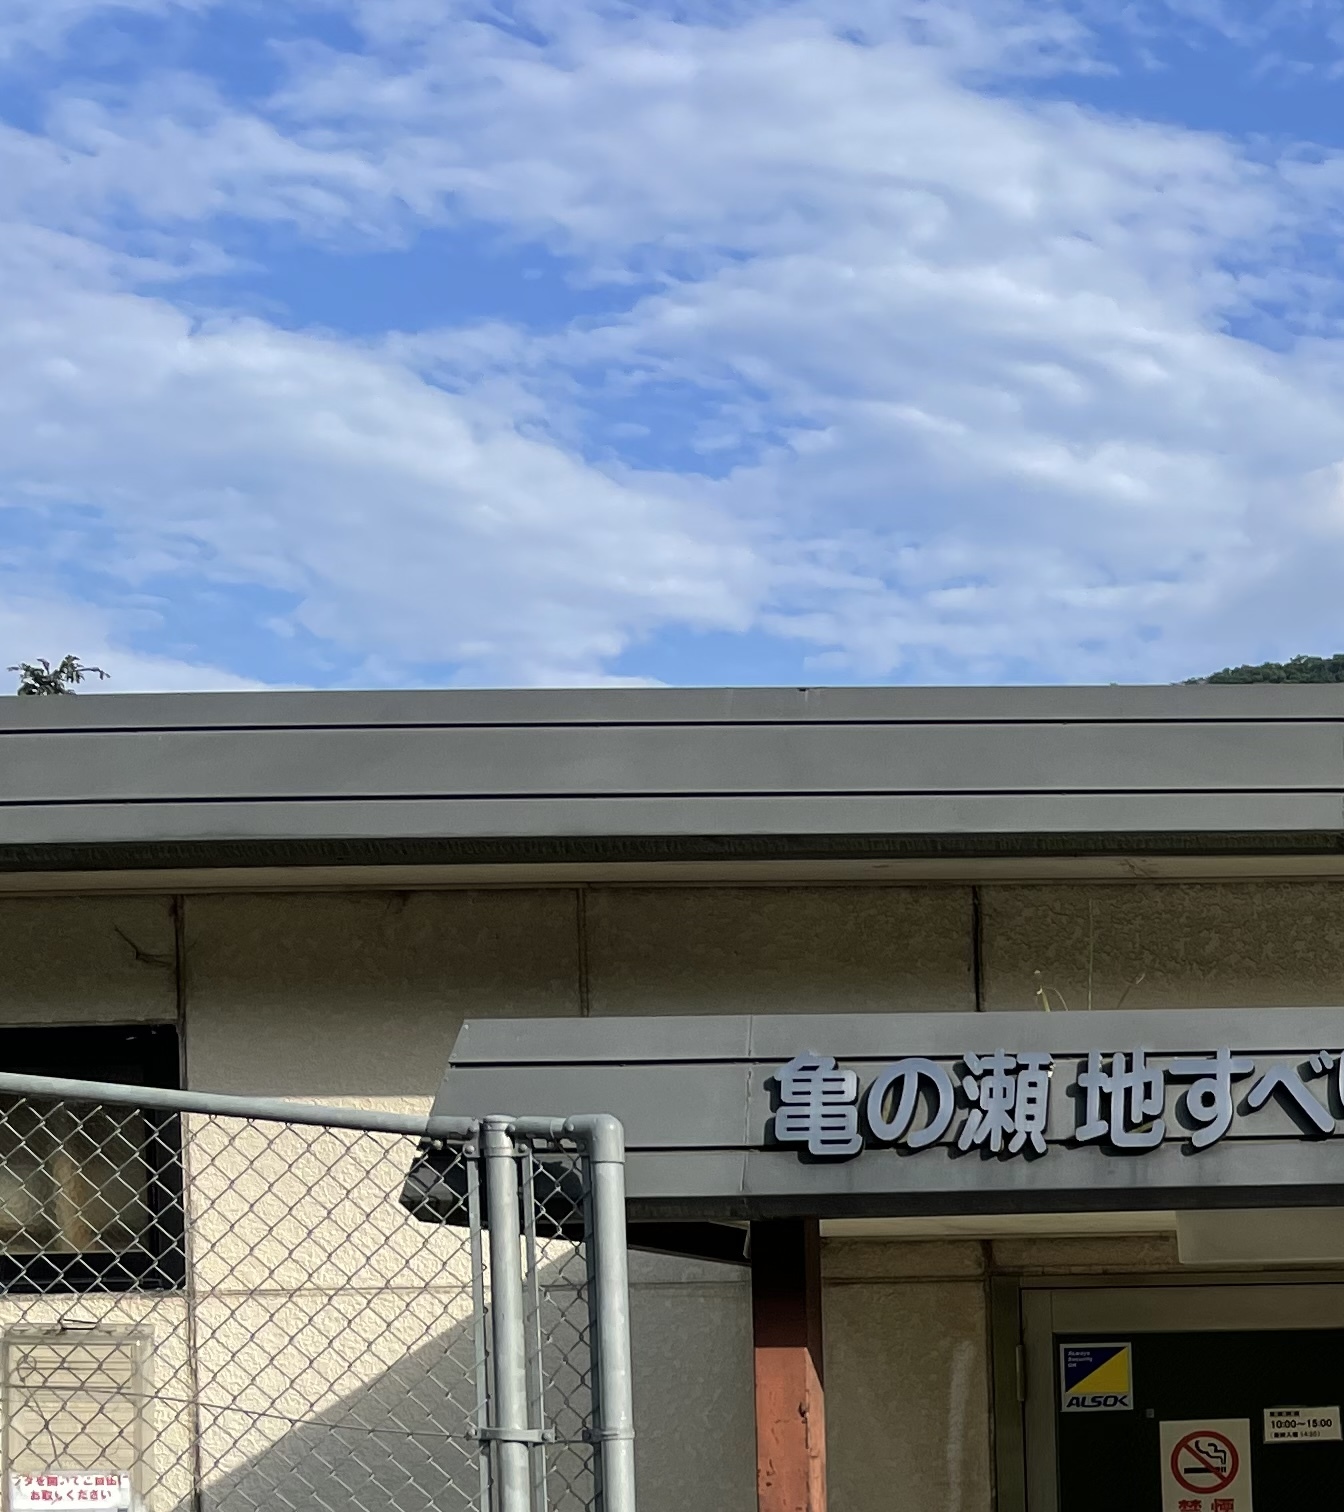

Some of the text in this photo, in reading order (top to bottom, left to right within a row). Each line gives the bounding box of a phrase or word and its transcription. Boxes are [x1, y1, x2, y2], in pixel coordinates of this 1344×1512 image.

[772, 1050, 1050, 1157] 亀の瀬
[1066, 1395, 1128, 1408] ALSOK
